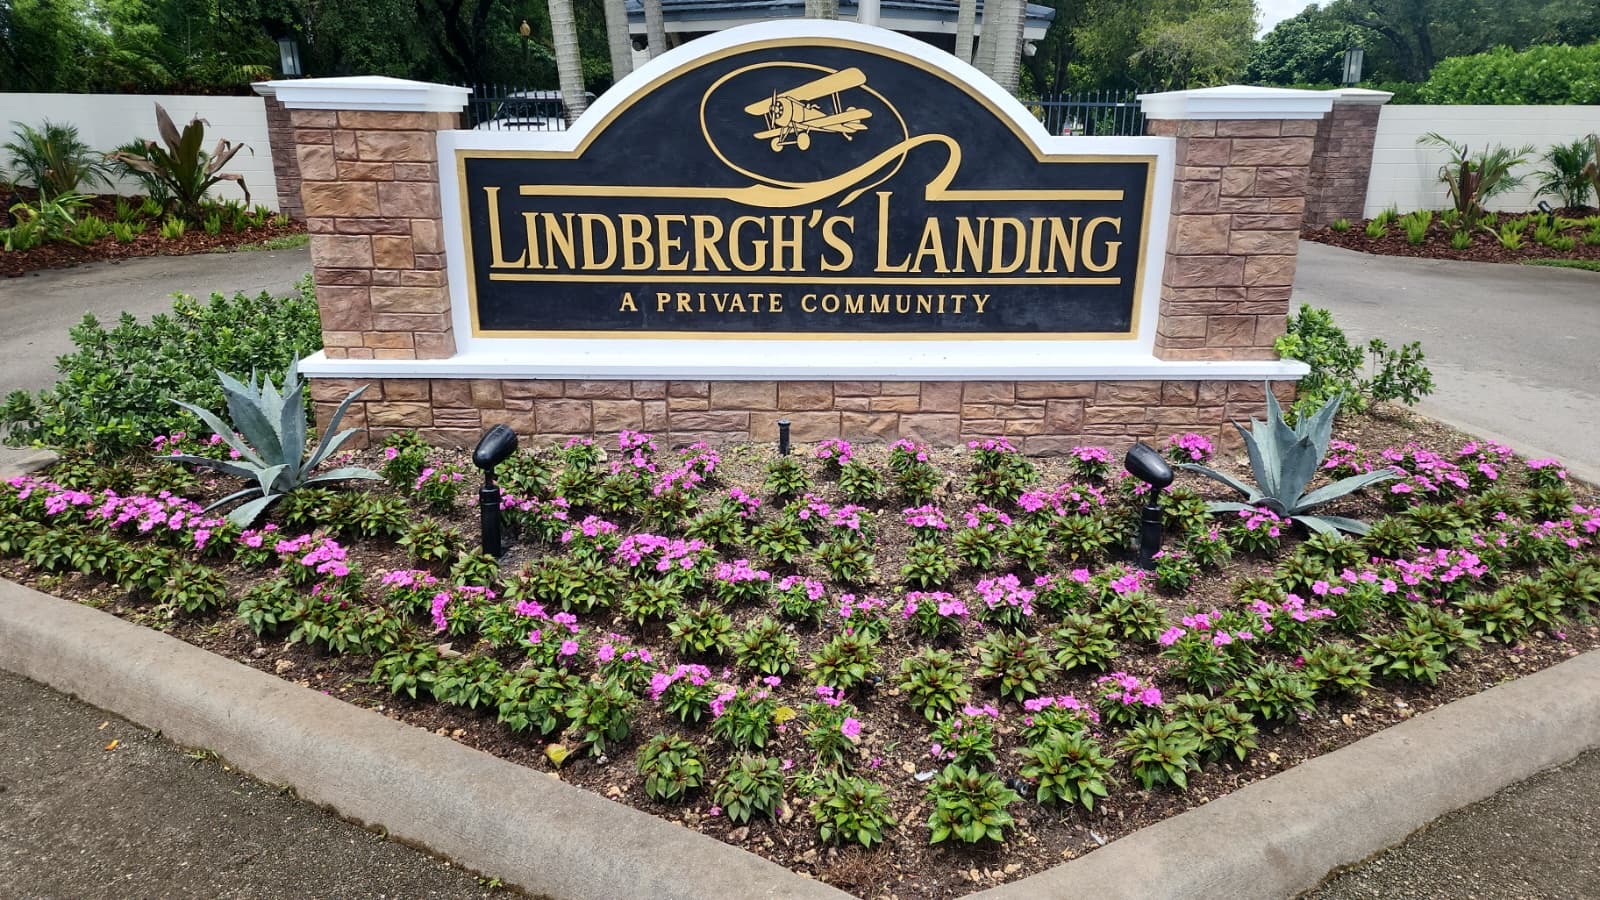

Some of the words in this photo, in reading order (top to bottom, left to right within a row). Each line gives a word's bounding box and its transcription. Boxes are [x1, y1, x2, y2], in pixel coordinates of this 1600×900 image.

[483, 186, 855, 273] LINDBERGH'S
[875, 191, 1123, 274] LANDING
[620, 292, 637, 313] A
[656, 292, 784, 313] PRIVATE
[801, 293, 991, 314] COMMUNITY
